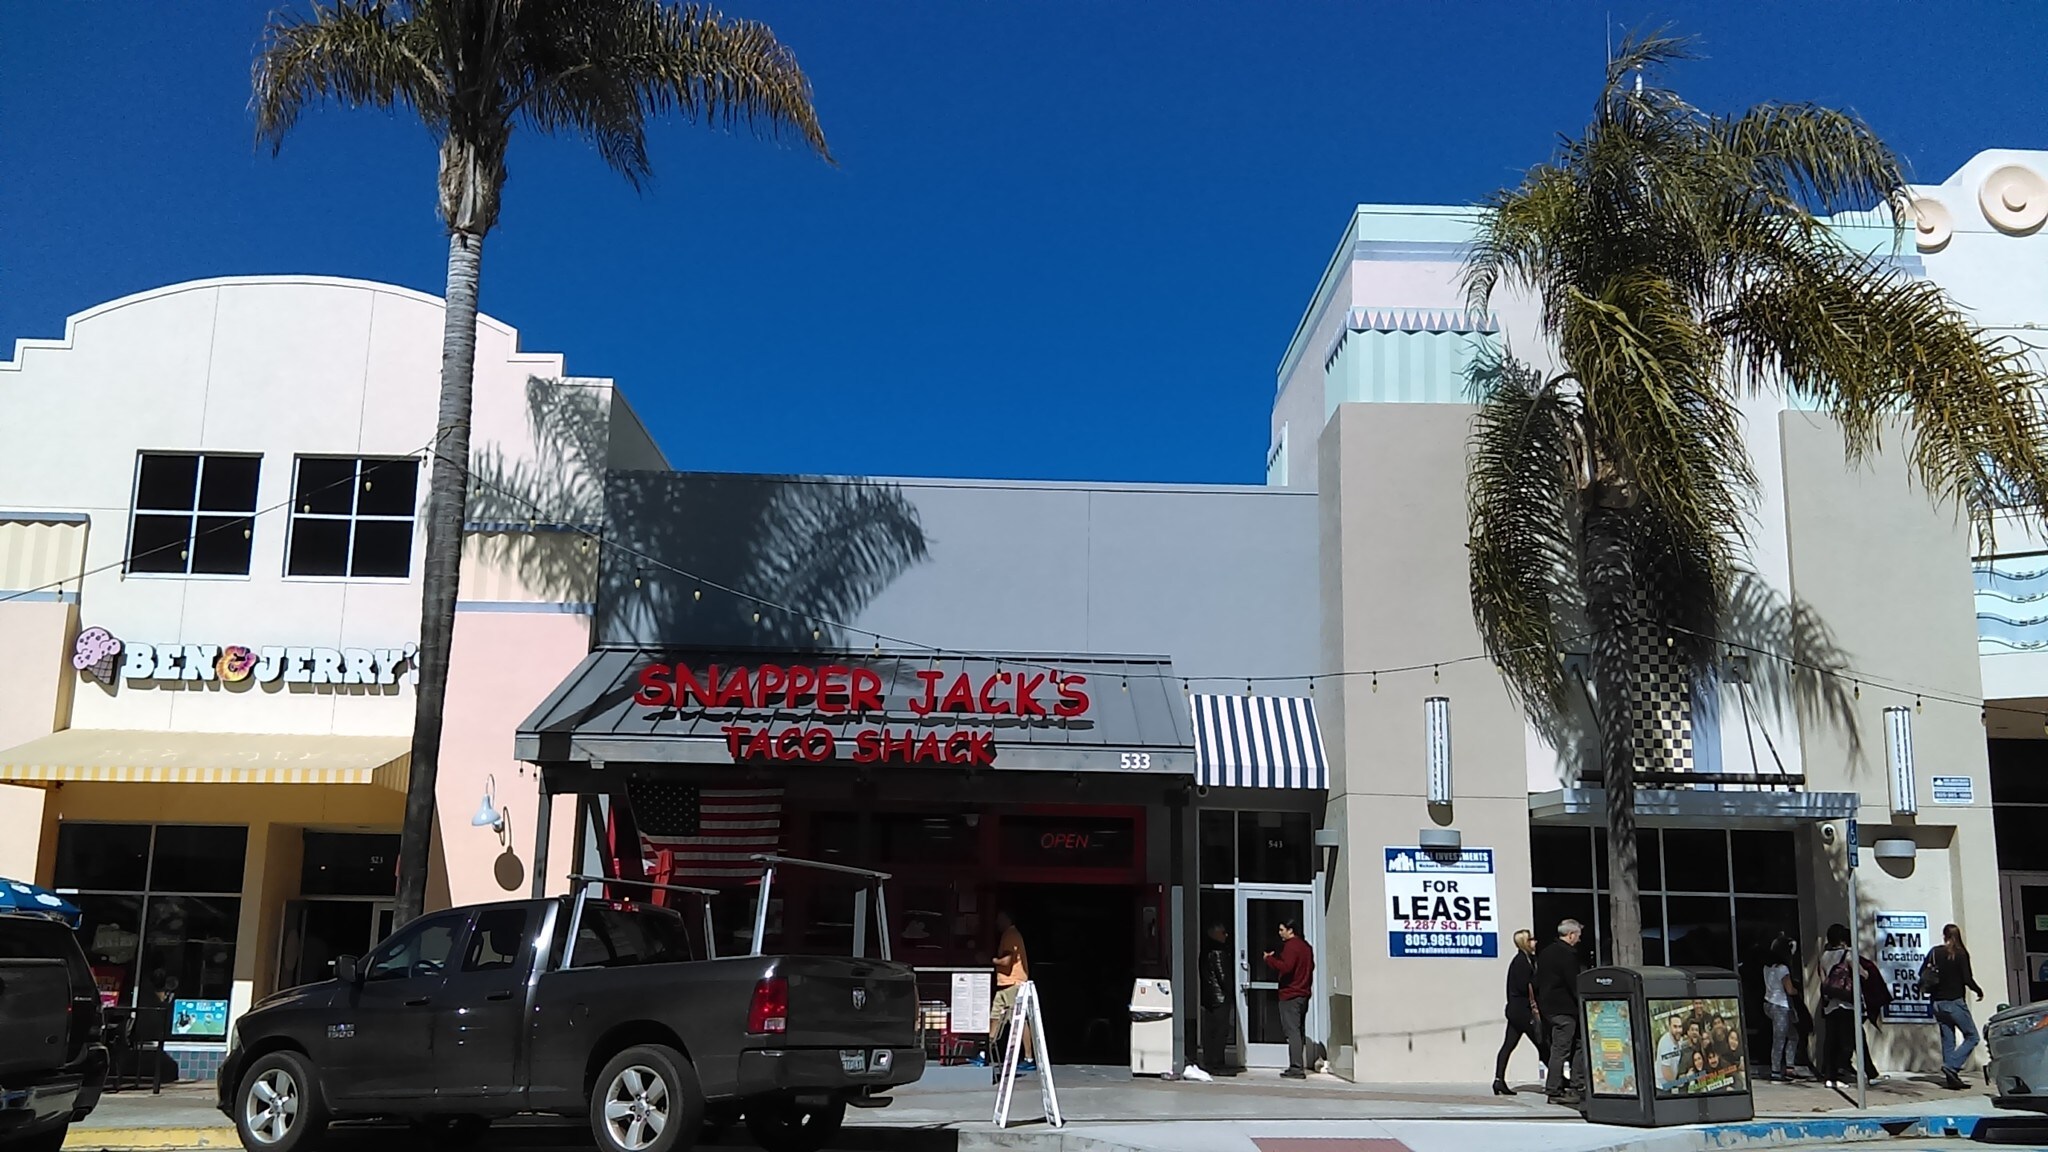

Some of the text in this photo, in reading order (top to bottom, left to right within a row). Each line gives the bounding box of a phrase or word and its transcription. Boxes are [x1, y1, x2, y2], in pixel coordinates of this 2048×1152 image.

[121, 642, 217, 680] BEN
[216, 645, 256, 682] &
[634, 663, 1090, 718] SNAPPER JACK'S
[721, 726, 997, 766] TACO SHACK
[1120, 753, 1151, 769] 533
[1041, 832, 1089, 848] OPEN
[1268, 840, 1283, 849] 543
[1435, 852, 1489, 862] INVESTMENTS
[1423, 880, 1459, 893] FOR
[1392, 896, 1492, 921] LEASE
[1404, 920, 1483, 931] 2,287 SQ. FT.
[1405, 934, 1483, 946] 805.985.1000
[1884, 932, 1922, 948] ATM
[1881, 950, 1926, 962] Location
[1894, 969, 1917, 980] FOR
[1892, 983, 1932, 1001] EAS
